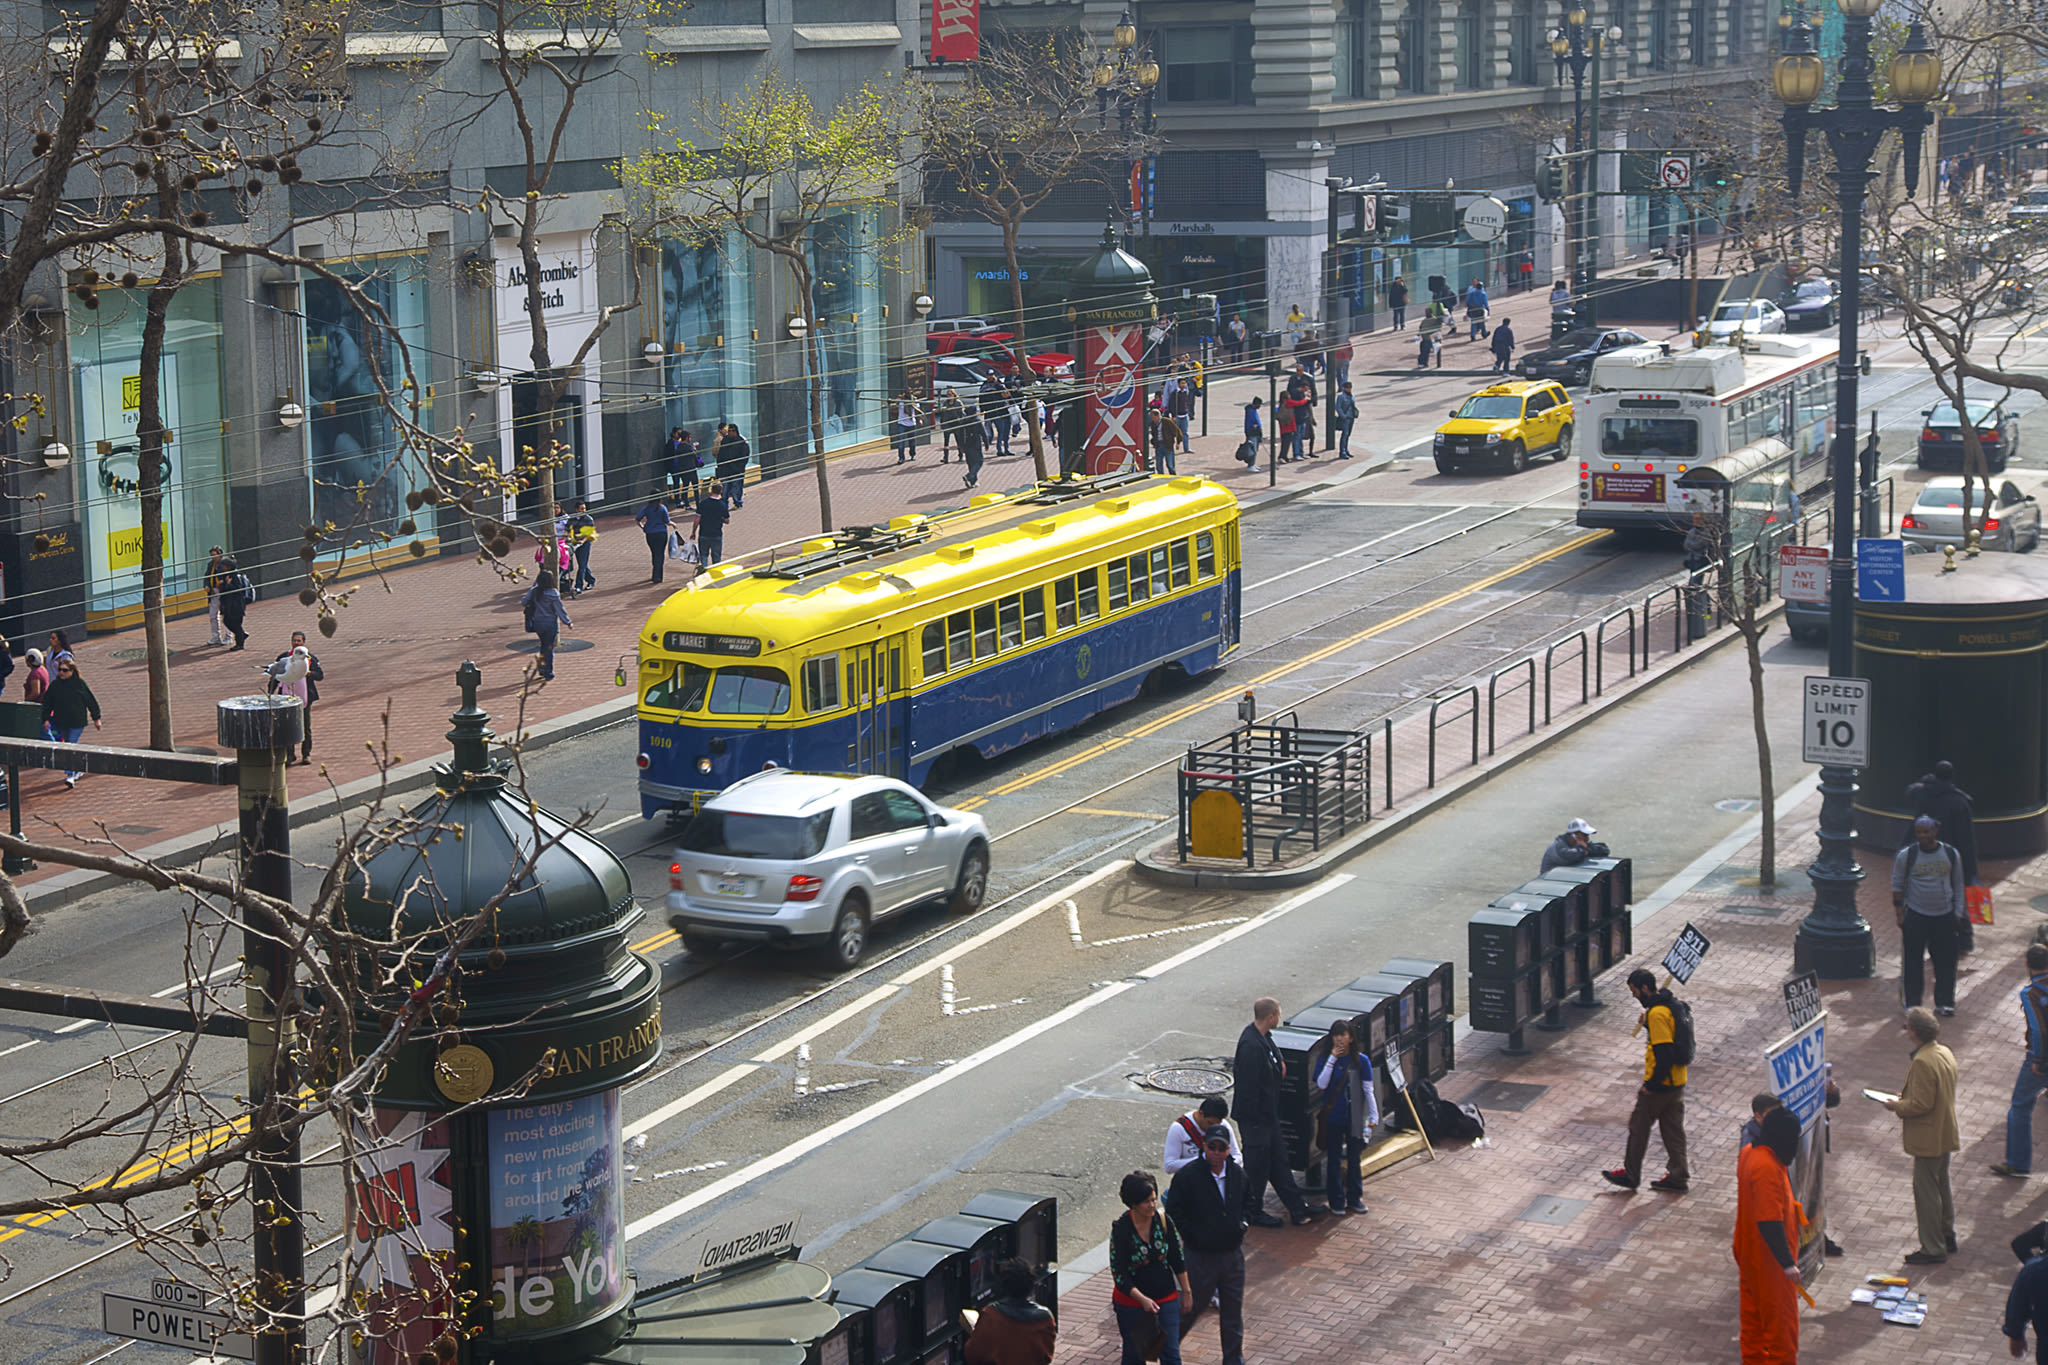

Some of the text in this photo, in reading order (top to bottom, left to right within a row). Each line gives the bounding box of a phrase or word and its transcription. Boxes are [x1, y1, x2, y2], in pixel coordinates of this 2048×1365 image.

[1169, 222, 1215, 234] Marshalls
[1471, 216, 1498, 224] FIFTH
[508, 261, 578, 287] Aberombie
[1102, 309, 1144, 320] FRANCISCO
[1781, 554, 1796, 565] NO
[1792, 580, 1817, 590] TIME
[1793, 570, 1815, 579] ANY
[671, 633, 678, 646] F
[679, 634, 707, 649] MARKET
[1958, 633, 2008, 645] POWELL
[1809, 684, 1864, 699] SPEED
[1814, 701, 1858, 715] LIMIT
[650, 735, 672, 748] 1010
[1816, 719, 1855, 748] 10
[1674, 937, 1701, 968] TRUTH
[1684, 930, 1705, 954] 9/11
[1664, 949, 1694, 981] NOW
[1788, 978, 1813, 997] 9/11
[1787, 988, 1820, 1014] TRUTH
[1790, 1004, 1822, 1031] NOW
[541, 1043, 593, 1079] SAN
[1772, 1036, 1814, 1089] WTC
[1815, 1027, 1825, 1060] 7
[506, 1100, 573, 1121] The city's
[504, 1114, 595, 1142] most exciting
[504, 1135, 596, 1164] new museum
[504, 1160, 585, 1185] for art from
[505, 1188, 559, 1208] around
[563, 1183, 582, 1197] the
[155, 1283, 183, 1301] 000
[492, 1265, 555, 1320] de
[133, 1308, 223, 1346] POWELL
